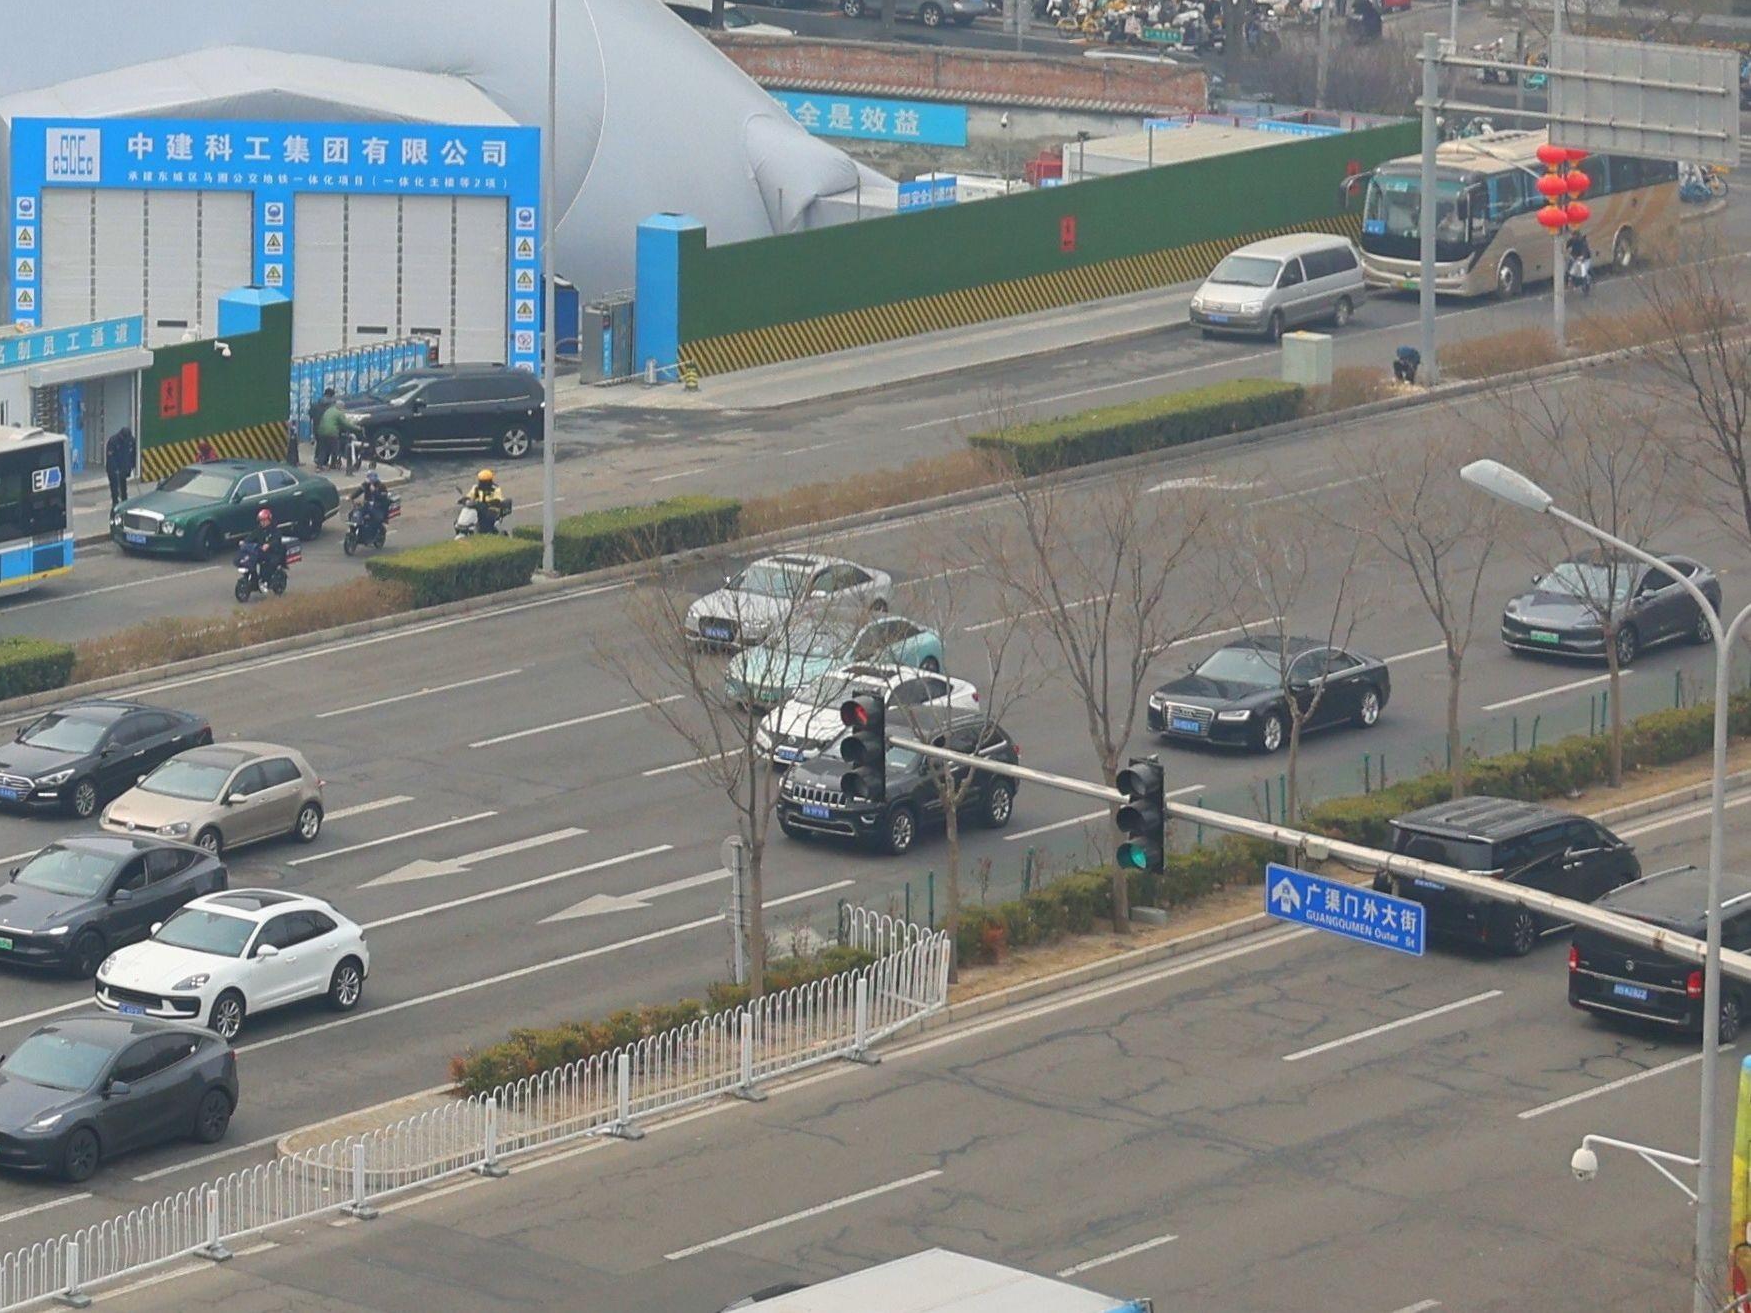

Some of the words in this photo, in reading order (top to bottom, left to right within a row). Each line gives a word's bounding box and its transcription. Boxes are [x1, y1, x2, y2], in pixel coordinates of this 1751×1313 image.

[127, 131, 507, 167] 中建科工集团有限公司
[1305, 883, 1417, 934] 广渠门外大街
[1306, 910, 1372, 937] GUANGQUMEN
[1374, 928, 1398, 942] Outer
